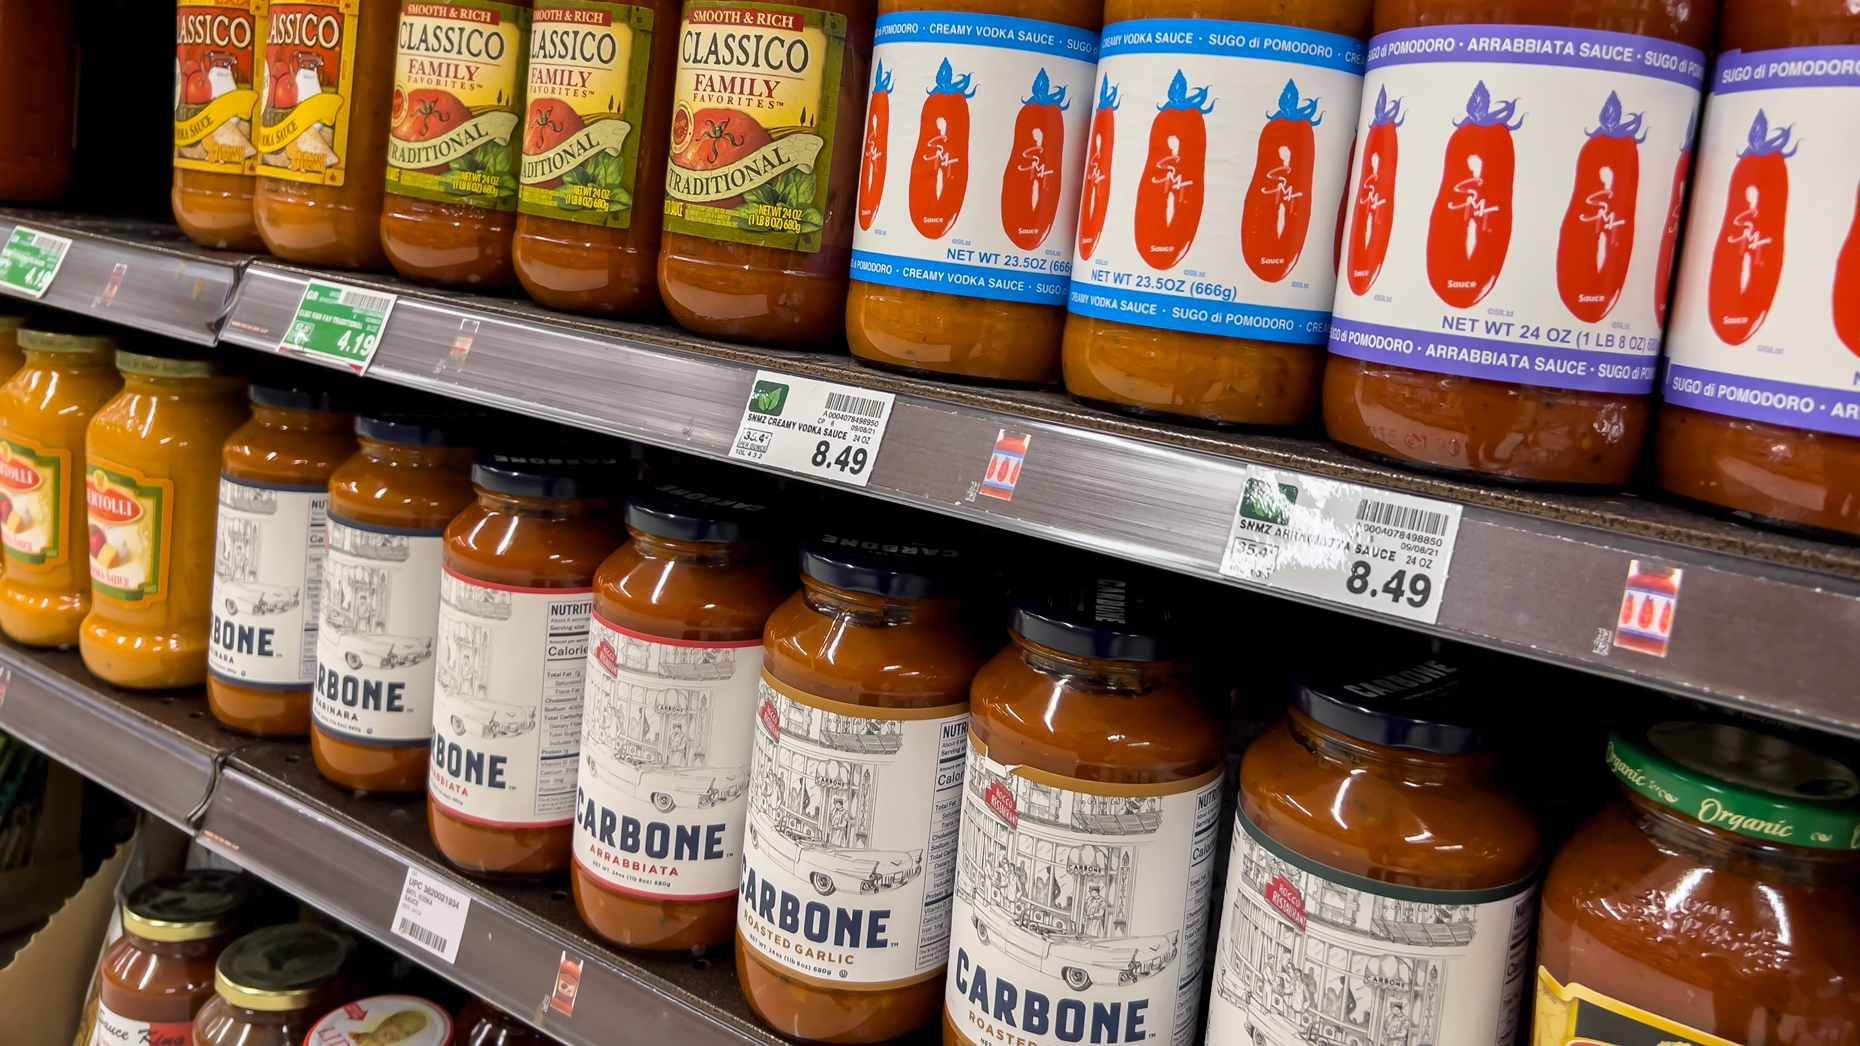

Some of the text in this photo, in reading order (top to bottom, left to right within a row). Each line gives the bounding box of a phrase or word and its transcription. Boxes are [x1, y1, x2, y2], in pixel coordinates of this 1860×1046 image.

[407, 4, 492, 23] SMOOTH & RICH
[564, 10, 604, 24] & RICH
[693, 10, 795, 29] SMOOTH & RICH
[399, 21, 505, 60] CLASSICO
[882, 23, 919, 35] POMODORO
[929, 23, 973, 36] CREAMY
[976, 26, 1015, 40] VODKA
[1017, 31, 1055, 46] SAUCE
[1066, 38, 1092, 53] SUGO
[1123, 32, 1333, 59] VODKA SAUCE SUGO di POMODORO
[682, 30, 809, 73] CLASSICO
[1388, 37, 1455, 56] POMODORO
[1467, 38, 1575, 56] ARRABBIATA
[1579, 42, 1633, 62] SAUCE
[1645, 51, 1678, 71] SUGO
[1679, 59, 1688, 74] di
[408, 58, 480, 81] FAMILY
[531, 67, 592, 88] FAMILY
[1721, 65, 1751, 84] SUGO
[1753, 64, 1766, 79] di
[693, 73, 781, 99] FAMILY
[189, 113, 214, 136] SAUCE
[275, 119, 299, 145] SAUCE
[490, 176, 500, 186] OZ
[668, 147, 791, 196] TRADITIONAL
[592, 188, 611, 200] 24 OZ
[758, 204, 803, 221] NET WT 24 OZ
[923, 216, 944, 224] Sauce
[756, 216, 801, 234] LB 8 OZ) 680g
[1018, 227, 1039, 235] Sauce
[946, 247, 1047, 271] NET WT 23.5OZ
[1150, 245, 1175, 253] Sauce
[1260, 256, 1285, 265] Sauce
[857, 260, 1061, 296] POMODORO CREAMY VODKA SAUCE SUGO
[1091, 268, 1238, 302] NET WT 23.5OZ (666g)
[1353, 269, 1369, 278] Sauce
[1447, 279, 1477, 289] Sauce
[1578, 294, 1605, 303] Sauce
[1090, 295, 1294, 331] VODKA SAUCE SUGO di POMODORO
[337, 330, 377, 357] 4.19
[1441, 315, 1480, 333] NET
[1484, 321, 1515, 338] WT
[1519, 325, 1540, 341] 24
[1545, 328, 1572, 344] OZ
[1575, 331, 1590, 349] (1
[1595, 333, 1615, 349] LB
[1618, 335, 1626, 350] 8
[1628, 335, 1646, 354] OZ)
[1349, 332, 1413, 354] POMODORO
[1425, 343, 1529, 370] ARRABBIATA
[1534, 357, 1586, 376] SAUCE
[1597, 363, 1629, 380] SUGO
[1631, 366, 1640, 380] di
[1672, 376, 1701, 395] SUGO
[1703, 383, 1714, 397] di
[1717, 384, 1815, 413] POMODORO
[747, 413, 848, 440] SNMZ CREAMY VODKA SAUCE
[850, 424, 876, 435] 09/08/21
[853, 434, 871, 444] 24 OZ
[811, 439, 868, 475] 8.49
[822, 534, 959, 558] CARBONE
[1354, 543, 1397, 562] SAUCE
[1400, 541, 1439, 557] 09/08/21
[1405, 555, 1433, 569] 24 OZ
[1346, 560, 1432, 608] 8.49
[317, 661, 406, 713] RBONE
[1343, 660, 1458, 698] CARBONE
[1605, 741, 1647, 787] Organic
[816, 777, 846, 788] CARBONE
[996, 786, 1013, 809] ROCCO
[577, 785, 727, 862] CARBONE
[1697, 797, 1795, 838] Organic
[589, 844, 679, 877] ARRABBIATA
[1068, 864, 1102, 874] CARBONE
[409, 877, 423, 890] UPC
[1279, 883, 1301, 908] ROCCO
[739, 852, 892, 949] CARBONE
[743, 908, 855, 965] ROASTED GARLIC
[812, 965, 832, 976] 680g
[1365, 976, 1407, 989] CARBONE
[955, 947, 1150, 1044] CARBONE
[99, 1008, 129, 1041] Sauce
